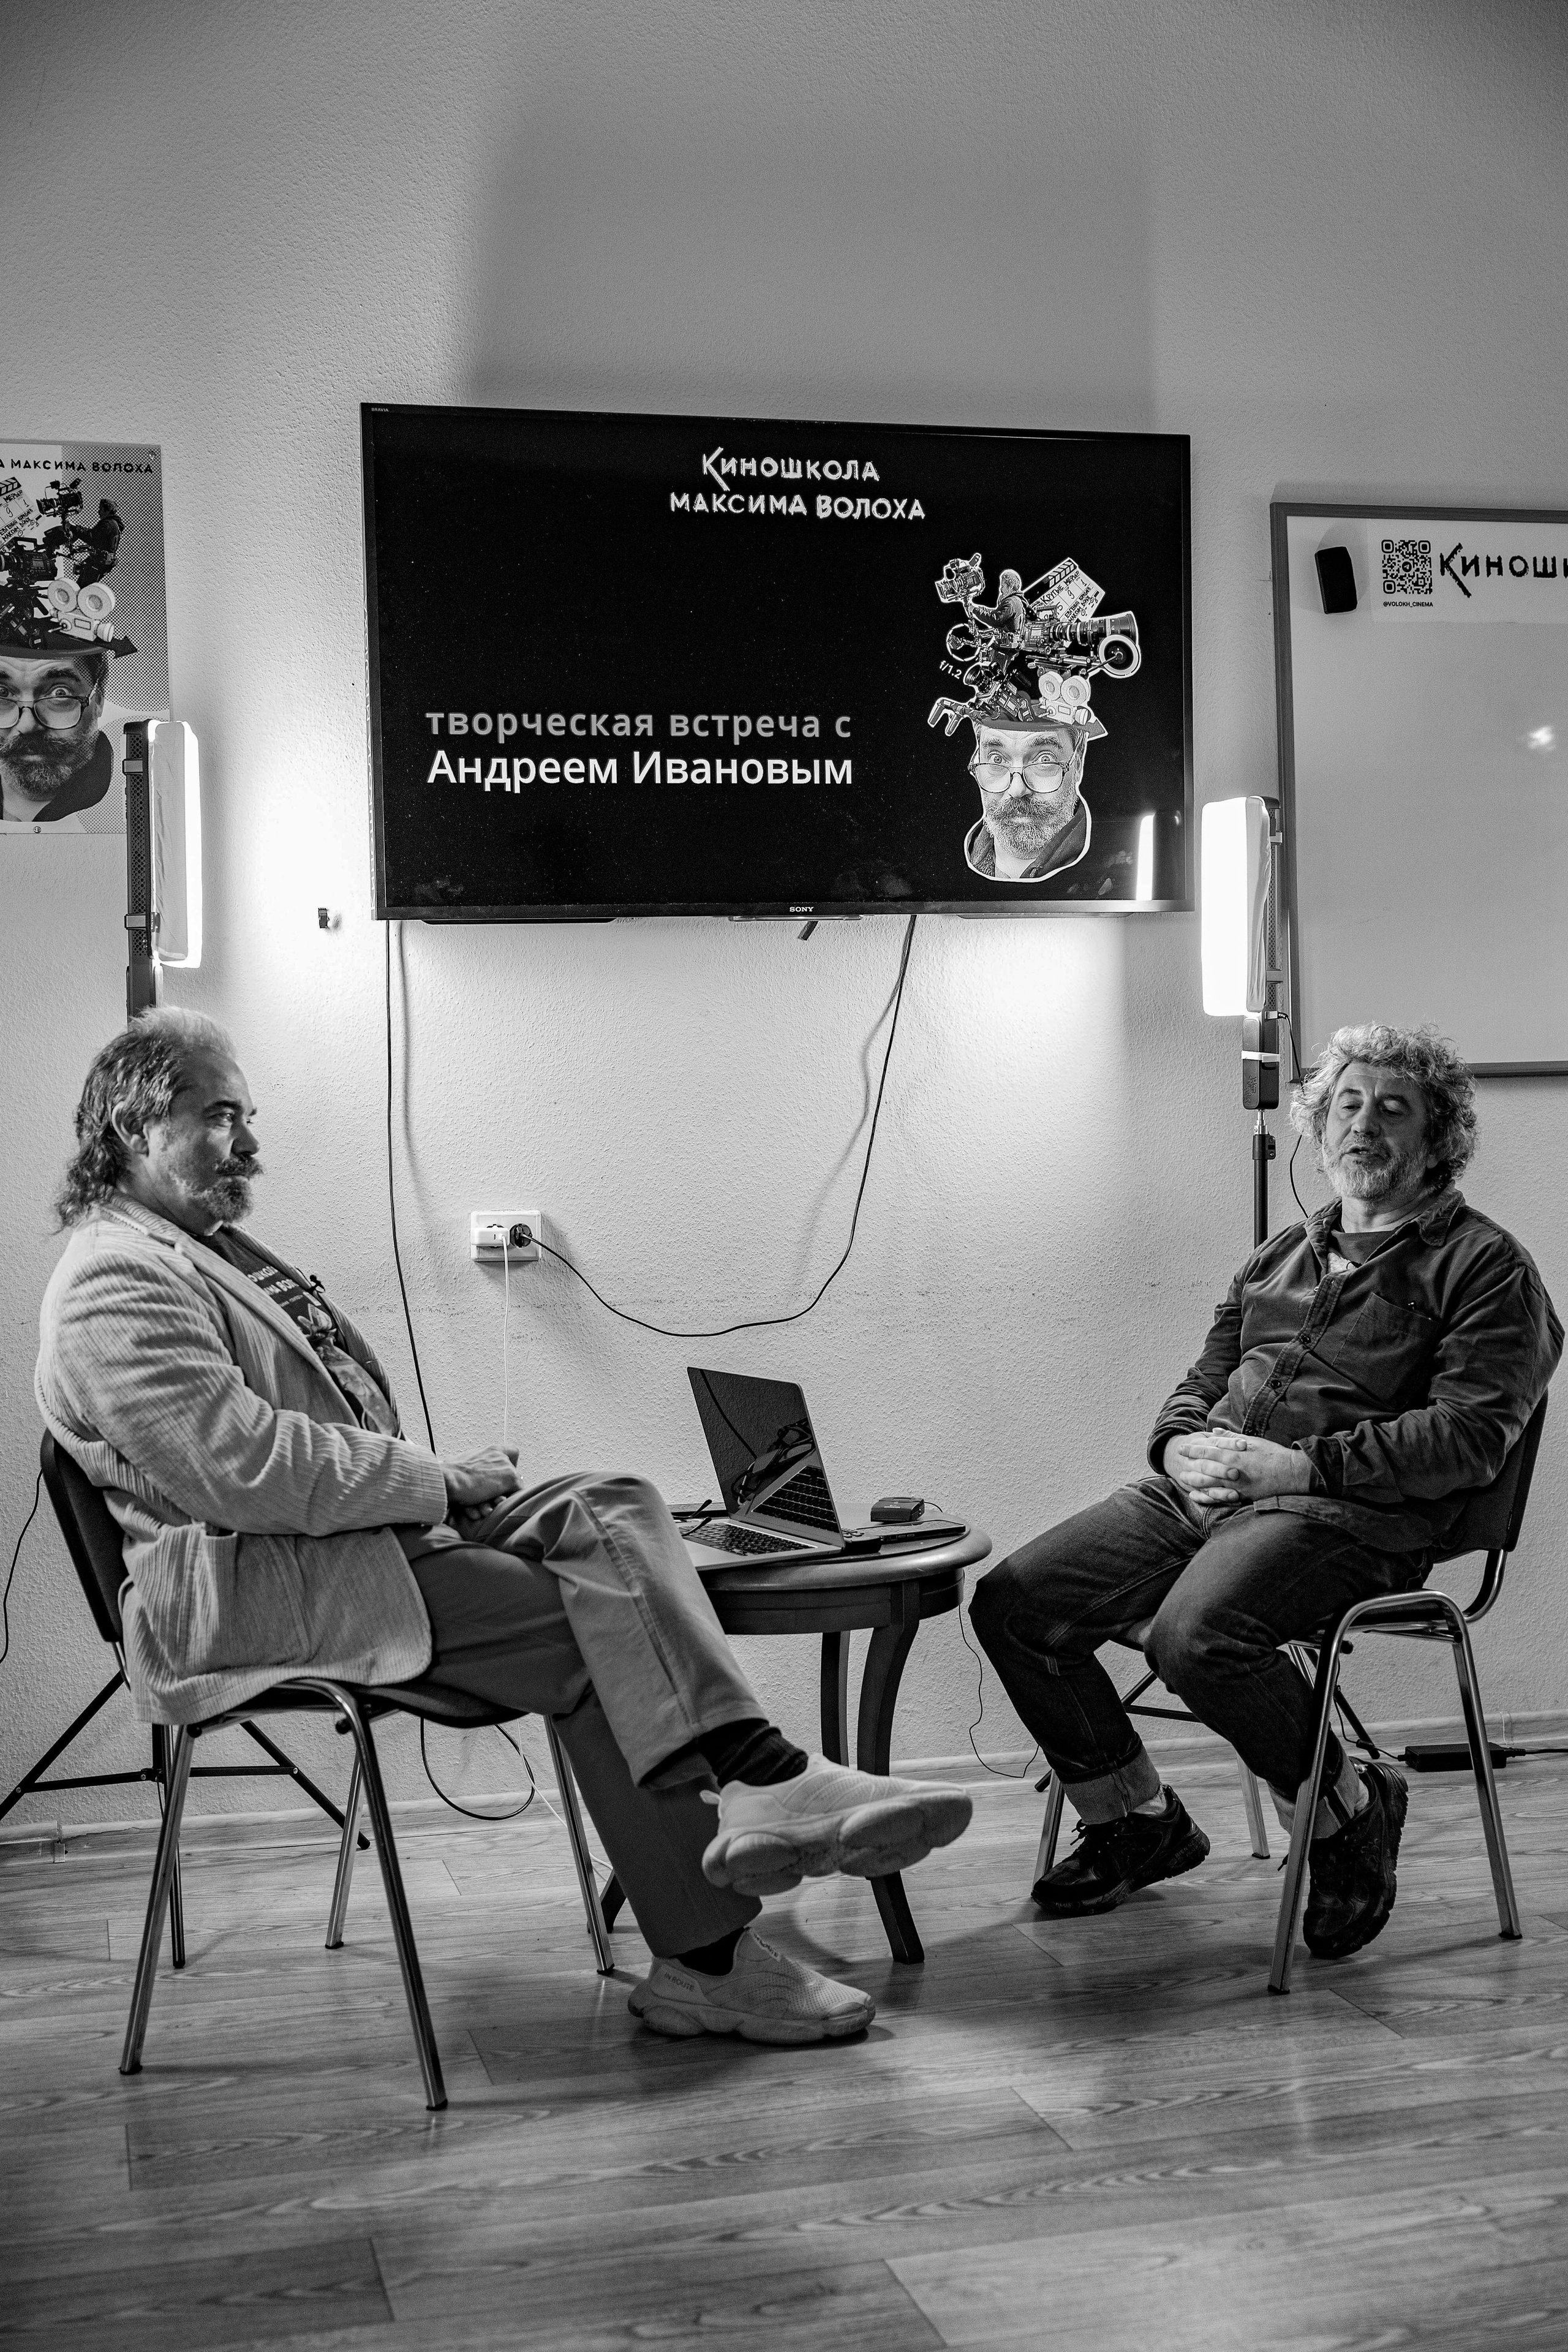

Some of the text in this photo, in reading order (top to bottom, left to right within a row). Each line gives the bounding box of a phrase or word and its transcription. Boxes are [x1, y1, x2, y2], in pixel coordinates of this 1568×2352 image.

[11, 459, 86, 472] МАКСИМА
[92, 462, 153, 474] ВОЛОХА
[669, 492, 925, 520] МАКСИМА ВОЛОХА
[940, 660, 962, 679] f/1.2
[425, 712, 851, 745] творческая встреча с
[427, 750, 852, 794] Андреем Ивановым
